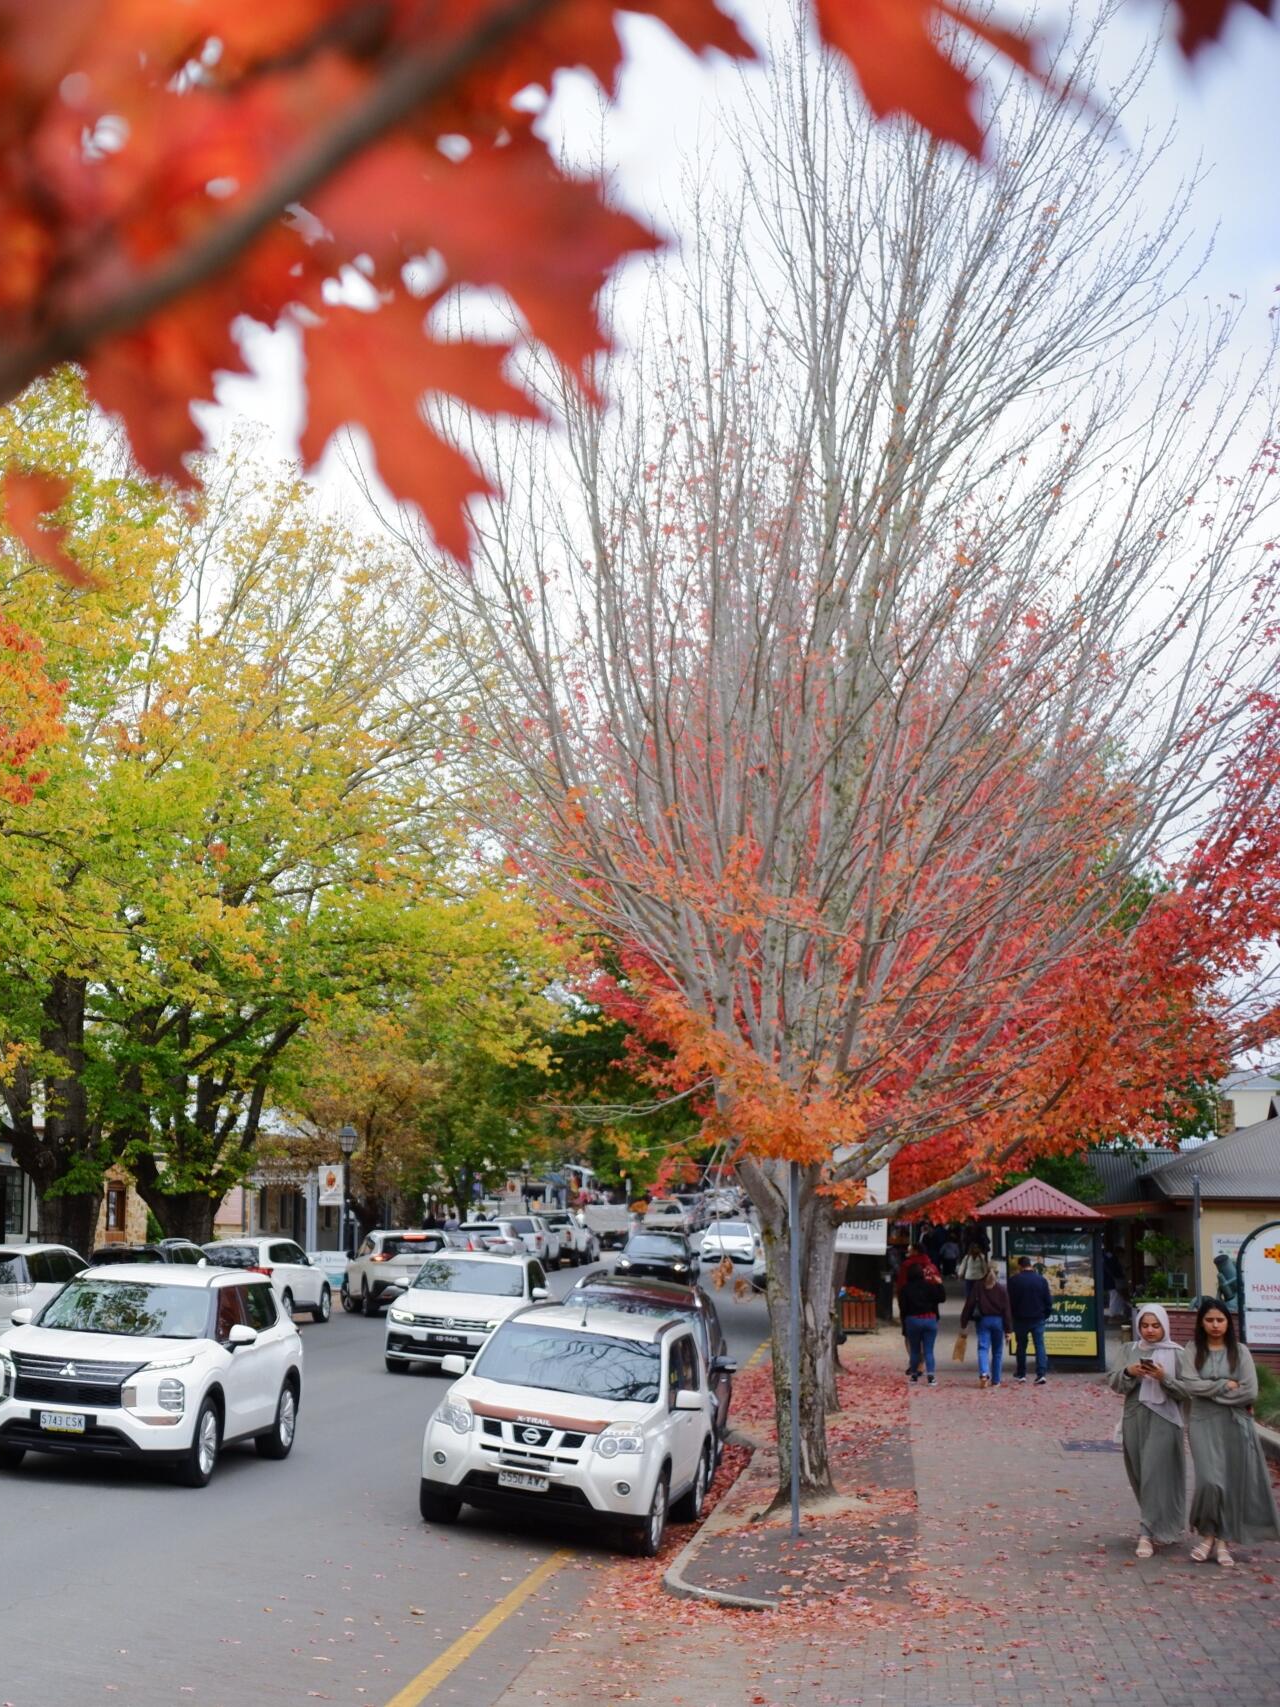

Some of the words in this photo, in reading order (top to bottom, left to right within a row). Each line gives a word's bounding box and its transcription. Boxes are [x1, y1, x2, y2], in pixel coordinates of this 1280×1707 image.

[1251, 1283, 1280, 1293] HAHN
[1060, 1314, 1082, 1323] 1000
[41, 1415, 62, 1426] S743
[65, 1417, 83, 1428] CSK
[516, 1415, 552, 1426] X-TRAIL
[500, 1471, 523, 1485] S550
